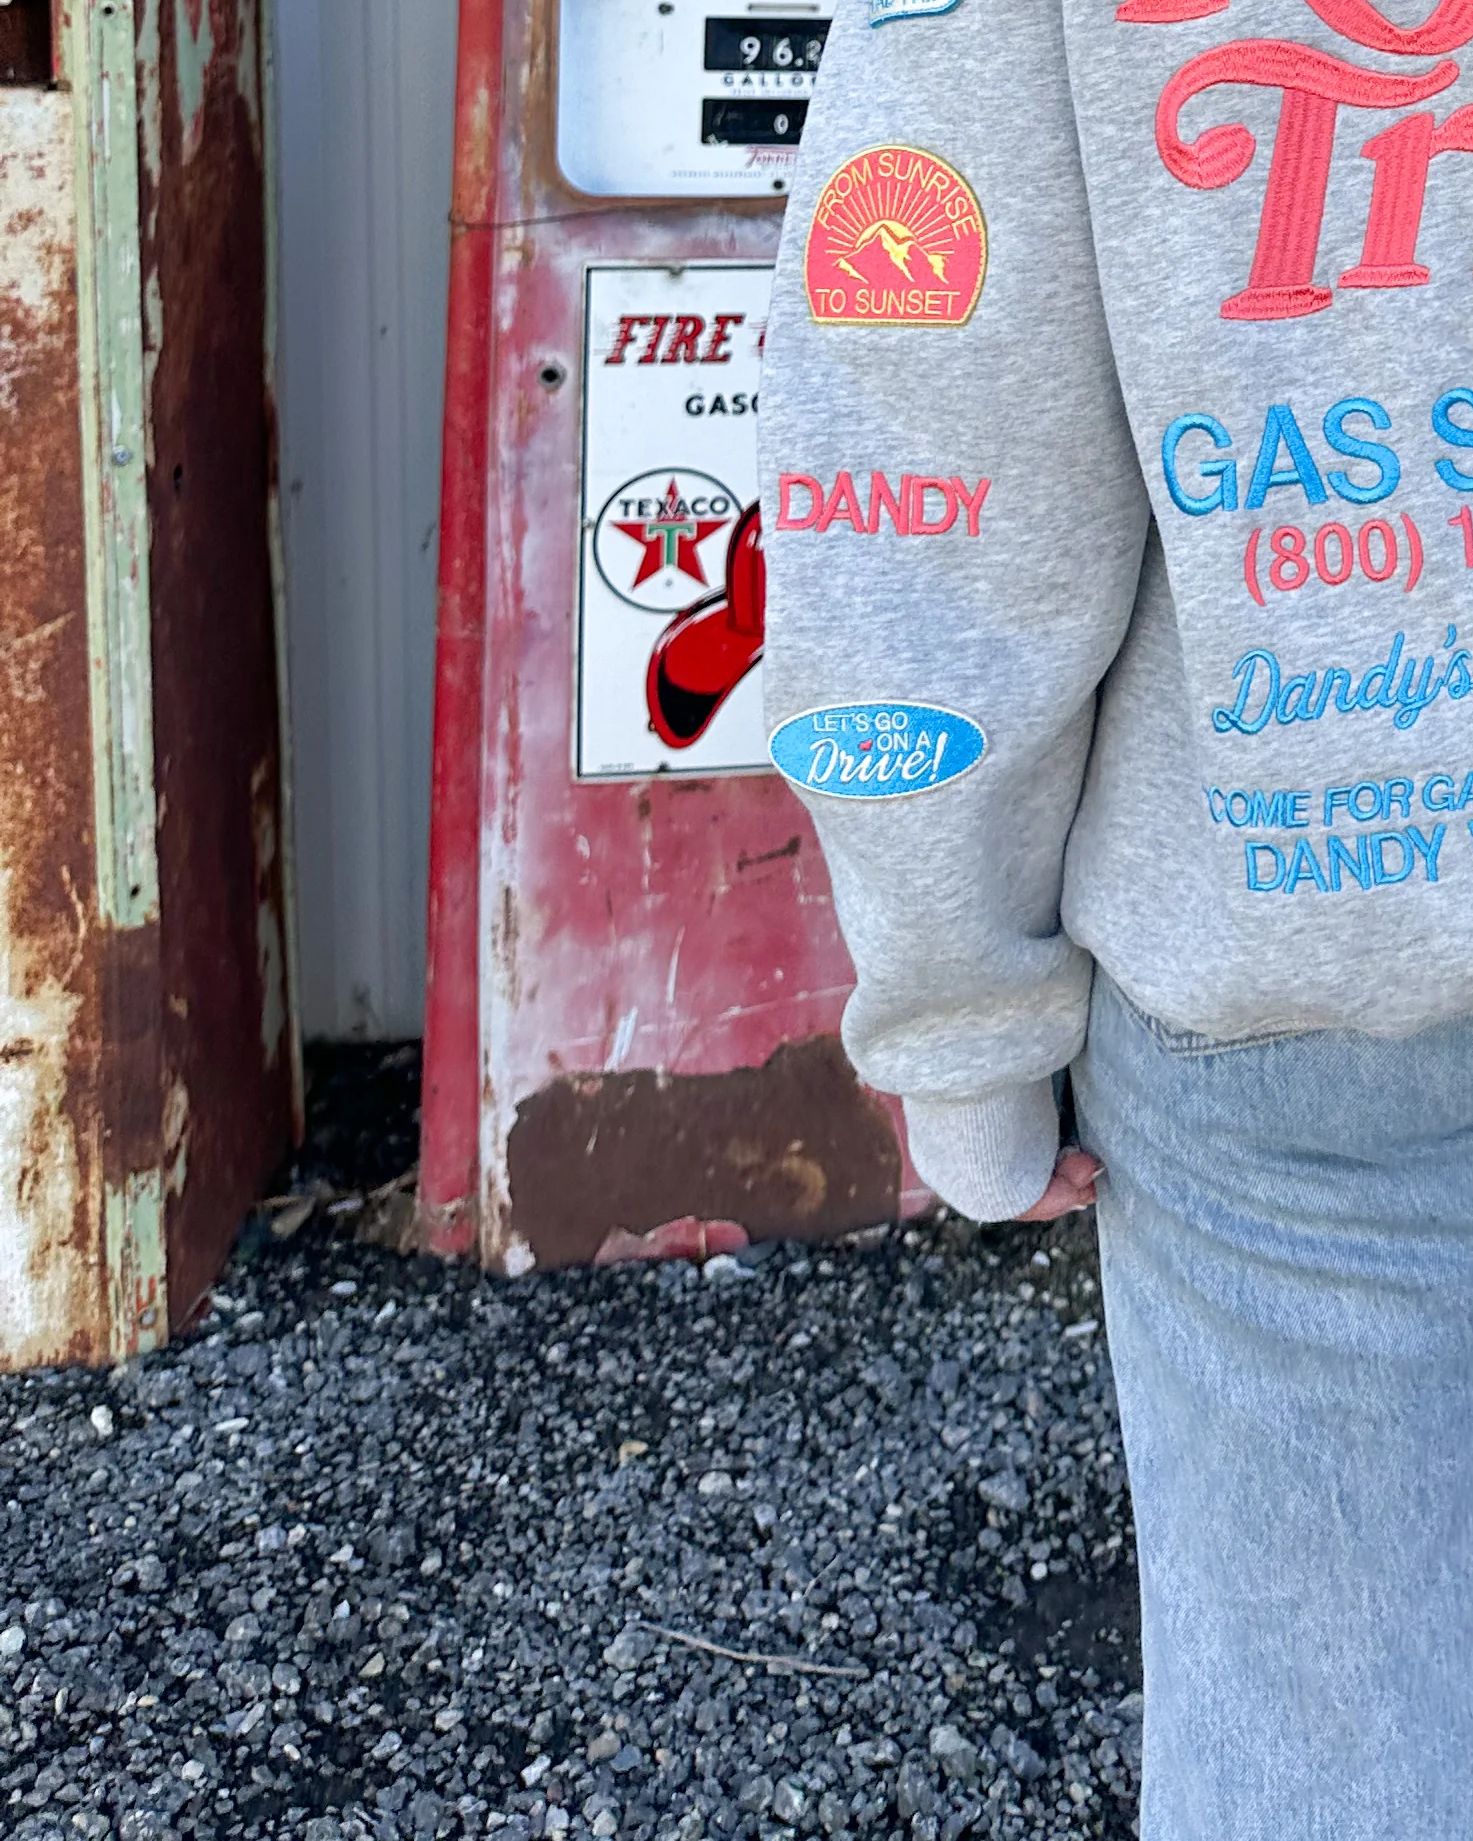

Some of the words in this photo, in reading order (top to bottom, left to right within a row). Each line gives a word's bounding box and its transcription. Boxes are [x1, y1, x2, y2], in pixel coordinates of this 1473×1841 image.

[817, 157, 873, 230] FROM
[878, 152, 977, 240] SUNRISE
[815, 289, 847, 314] TO
[856, 289, 961, 316] SUNSET
[604, 313, 746, 365] FIRE
[1162, 396, 1401, 517] GAS
[619, 496, 731, 517] TEXACO
[776, 470, 993, 537] DANDY
[1242, 513, 1424, 607] (800)
[812, 712, 869, 732] LET'S
[875, 711, 908, 732] GO
[876, 732, 909, 752] ON
[915, 730, 931, 751] A
[806, 731, 948, 784] Drive!
[1324, 777, 1414, 827] FOR
[1244, 823, 1446, 894] DANDY
